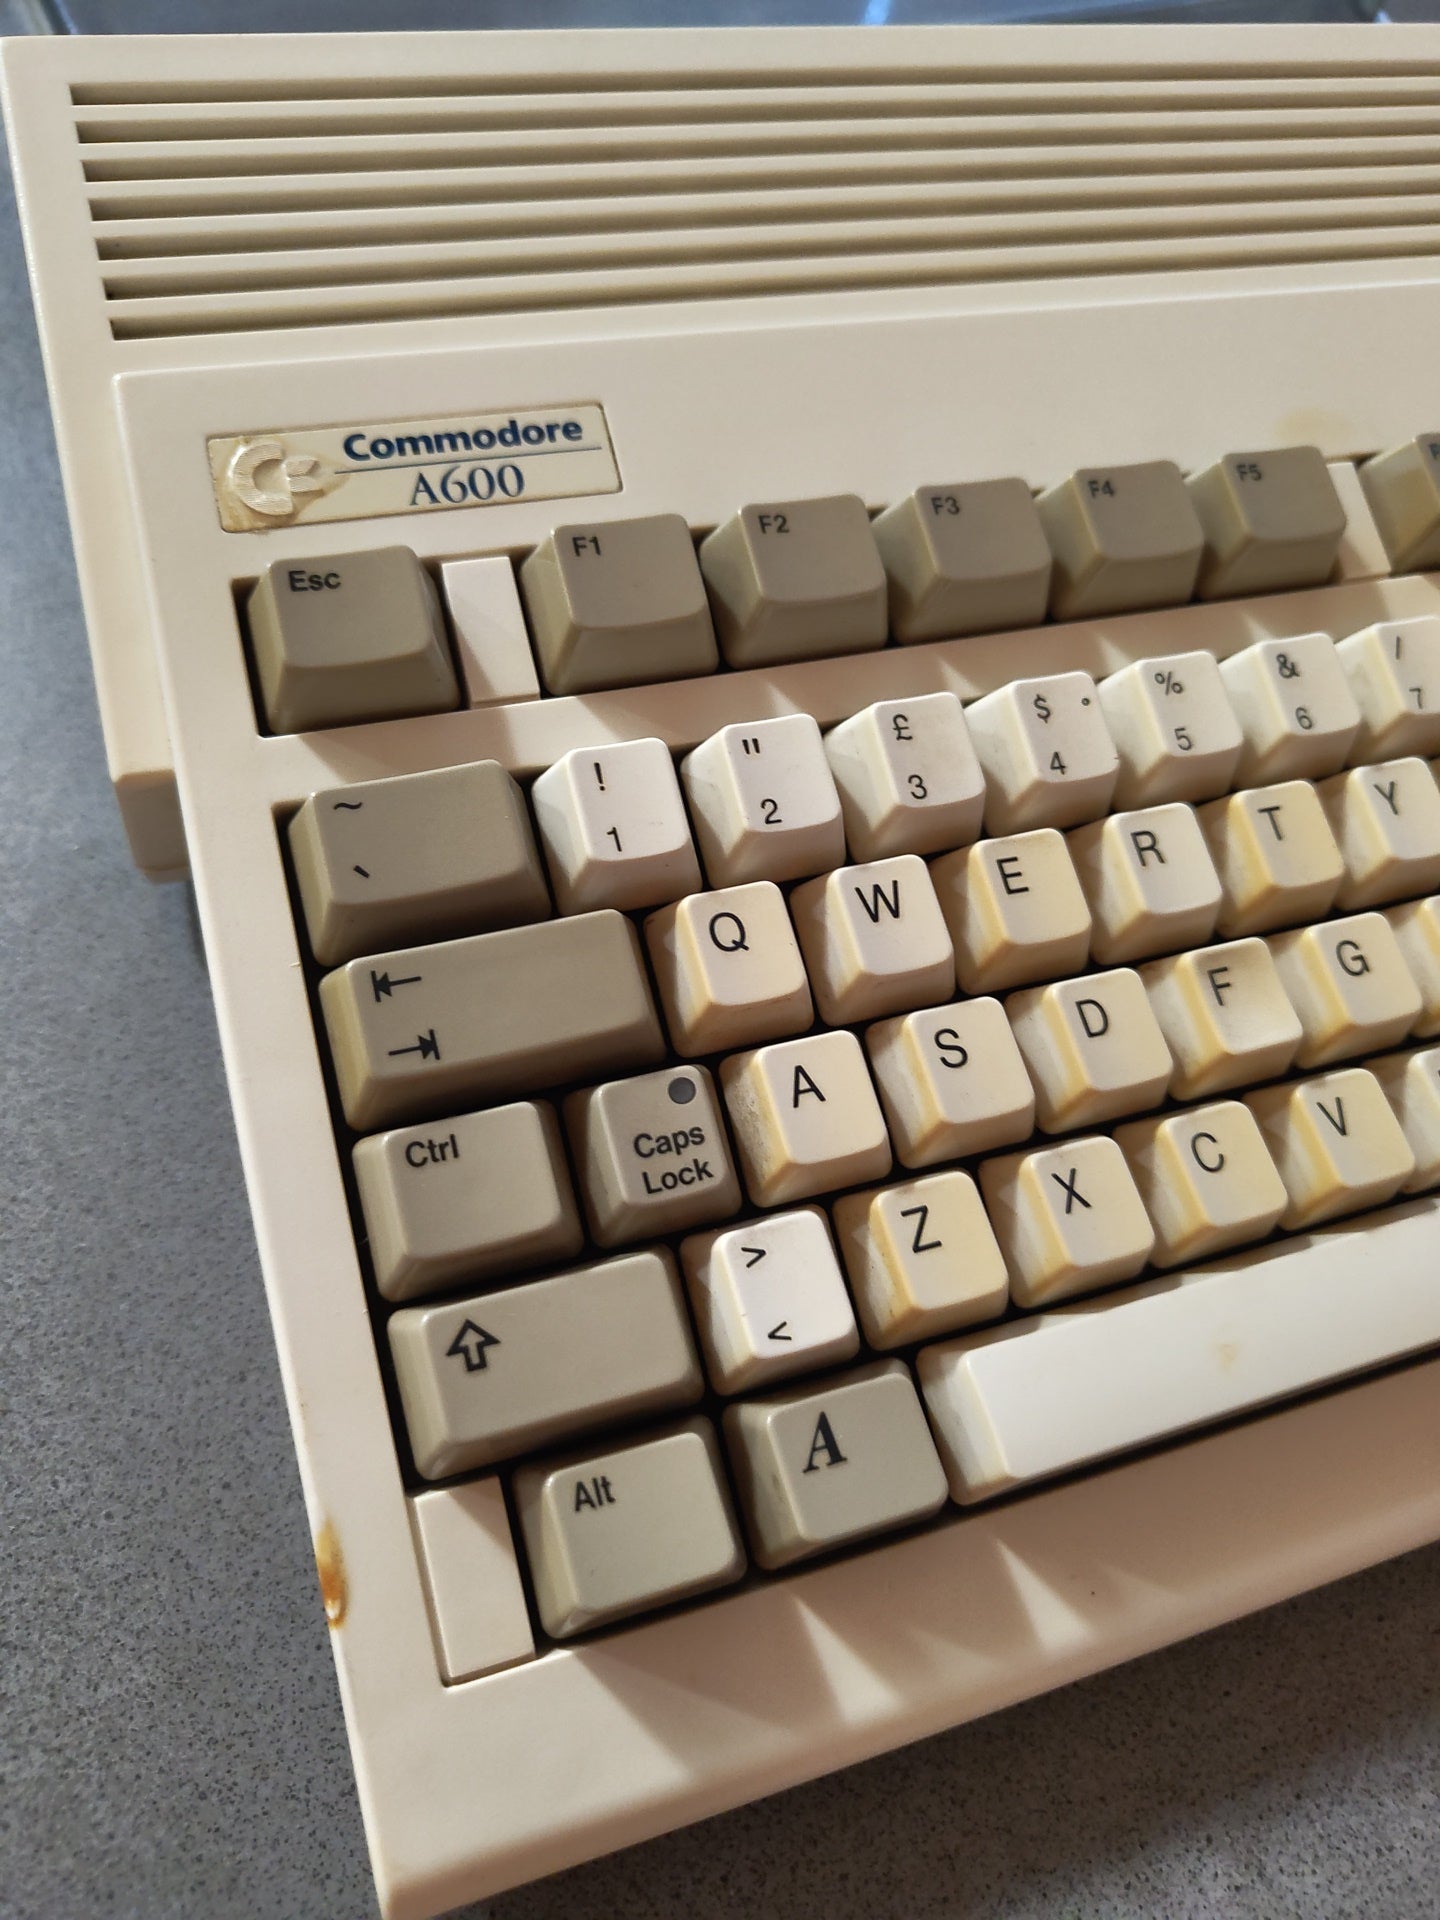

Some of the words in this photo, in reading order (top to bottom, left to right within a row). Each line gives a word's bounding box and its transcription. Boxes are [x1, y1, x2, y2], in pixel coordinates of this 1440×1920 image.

[342, 419, 584, 462] Commodore
[408, 463, 526, 507] A600
[1087, 479, 1116, 499] F4
[1235, 462, 1263, 482] F5
[930, 495, 961, 516] F3
[757, 513, 790, 535] F2
[571, 535, 602, 558] F1
[287, 569, 342, 593] Esc
[1154, 670, 1185, 696] %
[1275, 652, 1301, 680] &
[1033, 693, 1052, 724] $
[1408, 687, 1424, 710] 7
[892, 713, 914, 742] £
[1295, 706, 1315, 731] 6
[1173, 726, 1194, 752] 5
[593, 762, 606, 792] !
[1049, 751, 1067, 776] 4
[907, 774, 928, 800] 3
[1373, 780, 1400, 816] Y
[760, 798, 783, 825] 2
[1257, 805, 1284, 841] T
[606, 826, 623, 853] 1
[1130, 830, 1166, 868] R
[996, 856, 1030, 896] E
[854, 879, 901, 924] W
[708, 911, 750, 953] Q
[1335, 939, 1371, 977] G
[1206, 965, 1232, 1007] F
[1074, 998, 1110, 1039] D
[933, 1028, 969, 1069] S
[792, 1064, 827, 1109] A
[1316, 1096, 1349, 1137] V
[404, 1133, 461, 1168] Ctrl
[632, 1123, 707, 1160] Caps
[1190, 1131, 1225, 1174] C
[642, 1156, 714, 1195] Lock
[1051, 1167, 1092, 1215] X
[900, 1204, 943, 1254] Z
[740, 1246, 767, 1269] >
[767, 1321, 793, 1341] <
[802, 1411, 848, 1475] A
[574, 1475, 616, 1514] Alt
